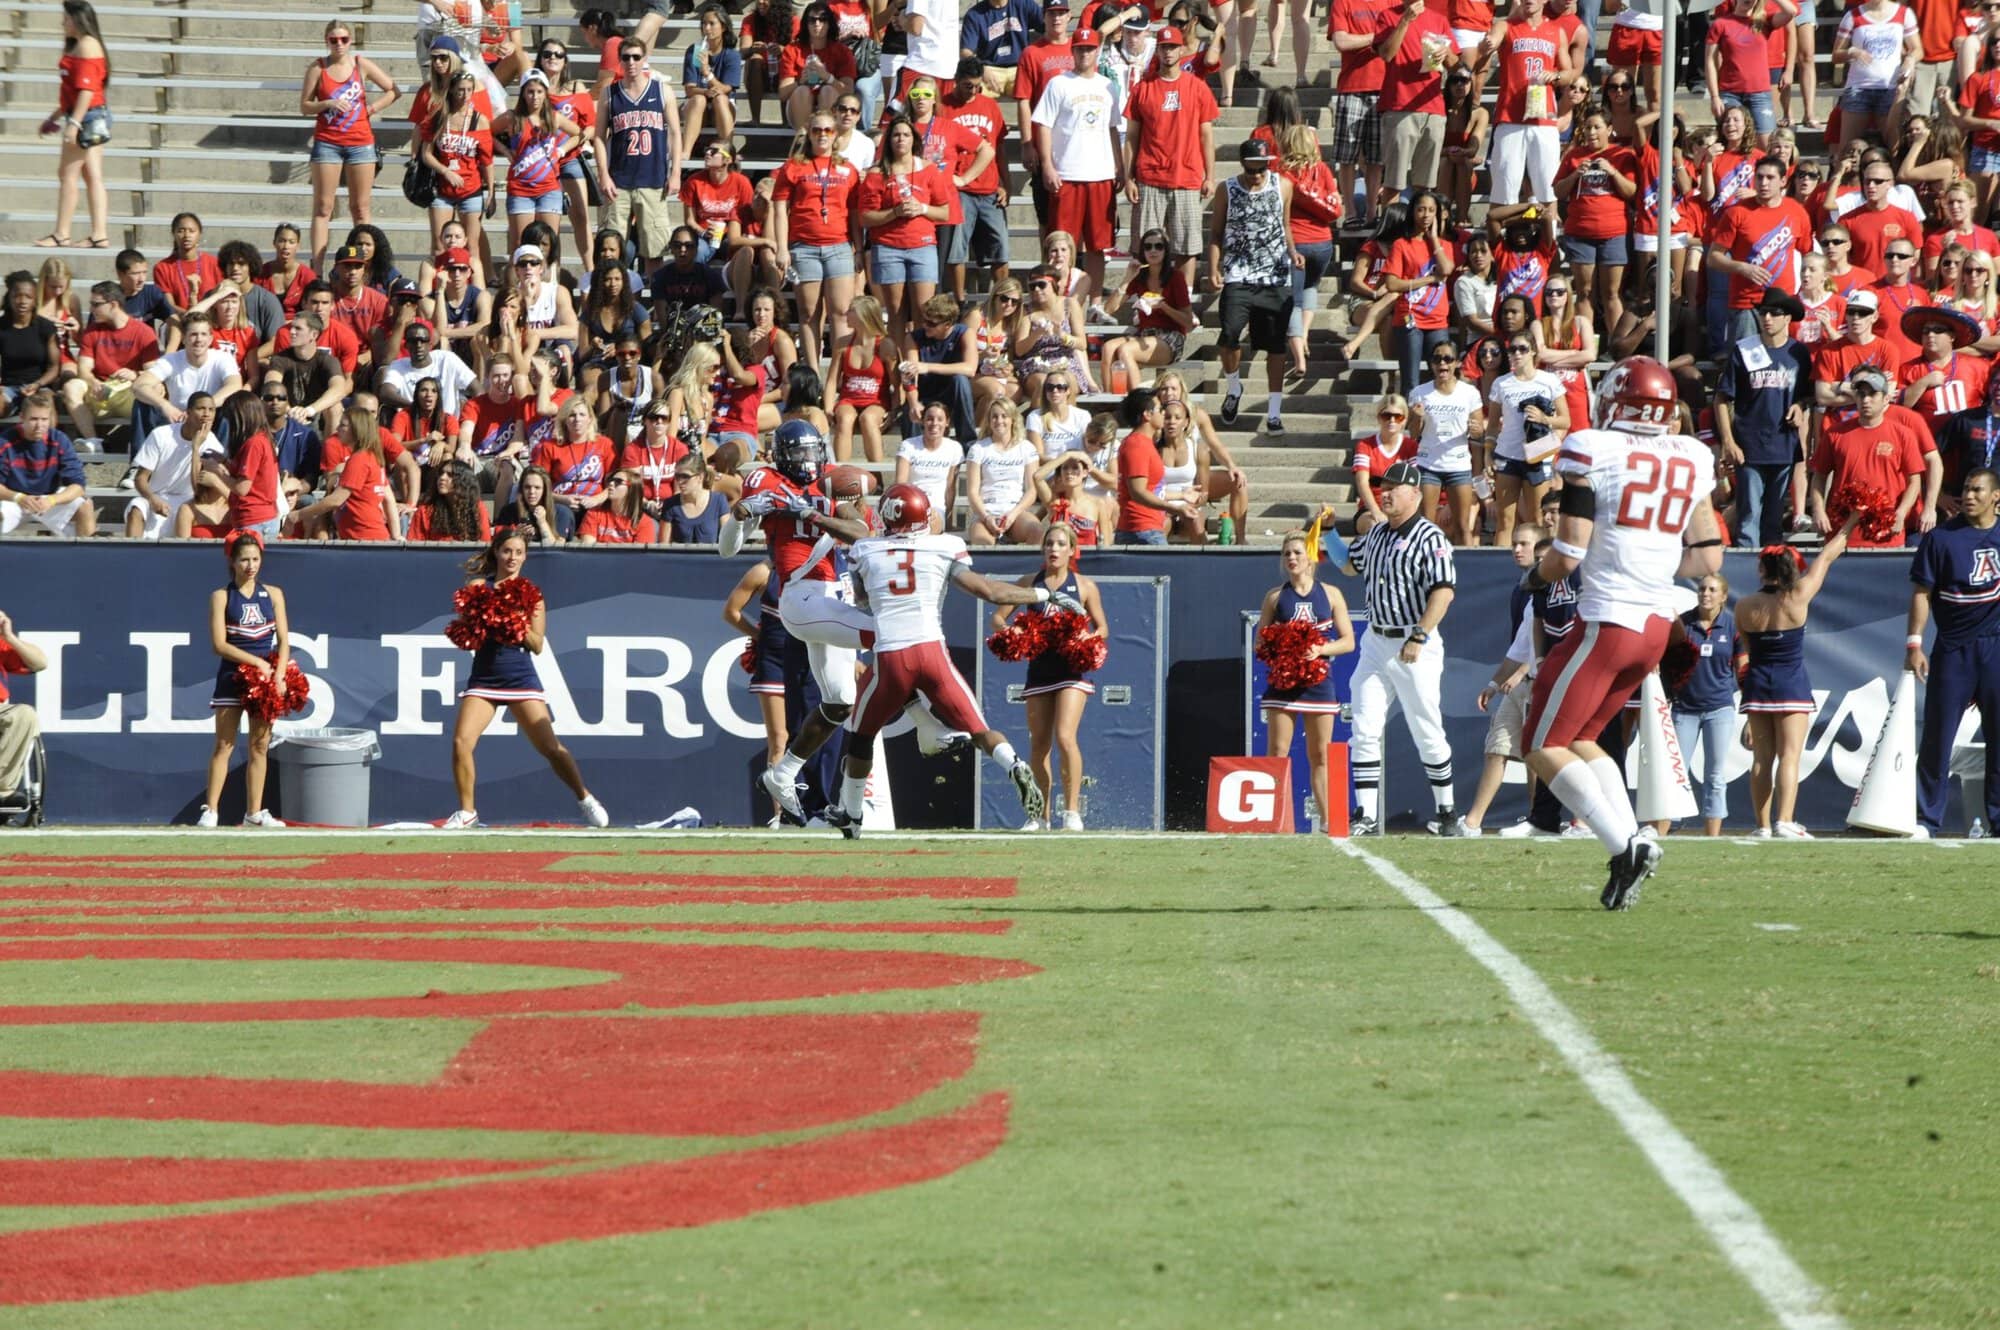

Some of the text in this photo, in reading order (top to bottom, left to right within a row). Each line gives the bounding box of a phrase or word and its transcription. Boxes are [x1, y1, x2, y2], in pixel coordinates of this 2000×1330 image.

[1081, 30, 1090, 40] T
[1512, 38, 1555, 55] ARIZONA
[1161, 90, 1183, 112] A
[611, 110, 664, 134] ARIZONA
[627, 129, 652, 156] 20
[404, 281, 416, 290] A
[1933, 380, 1968, 415] 10
[1640, 404, 1664, 422] 28
[1616, 451, 1697, 535] 28
[887, 549, 916, 596] 3
[1970, 548, 2000, 585] A
[1548, 579, 1578, 608] A
[239, 603, 267, 627] A
[1290, 602, 1318, 625] A
[1654, 697, 1686, 784] ARIZONA
[1217, 770, 1276, 823] G
